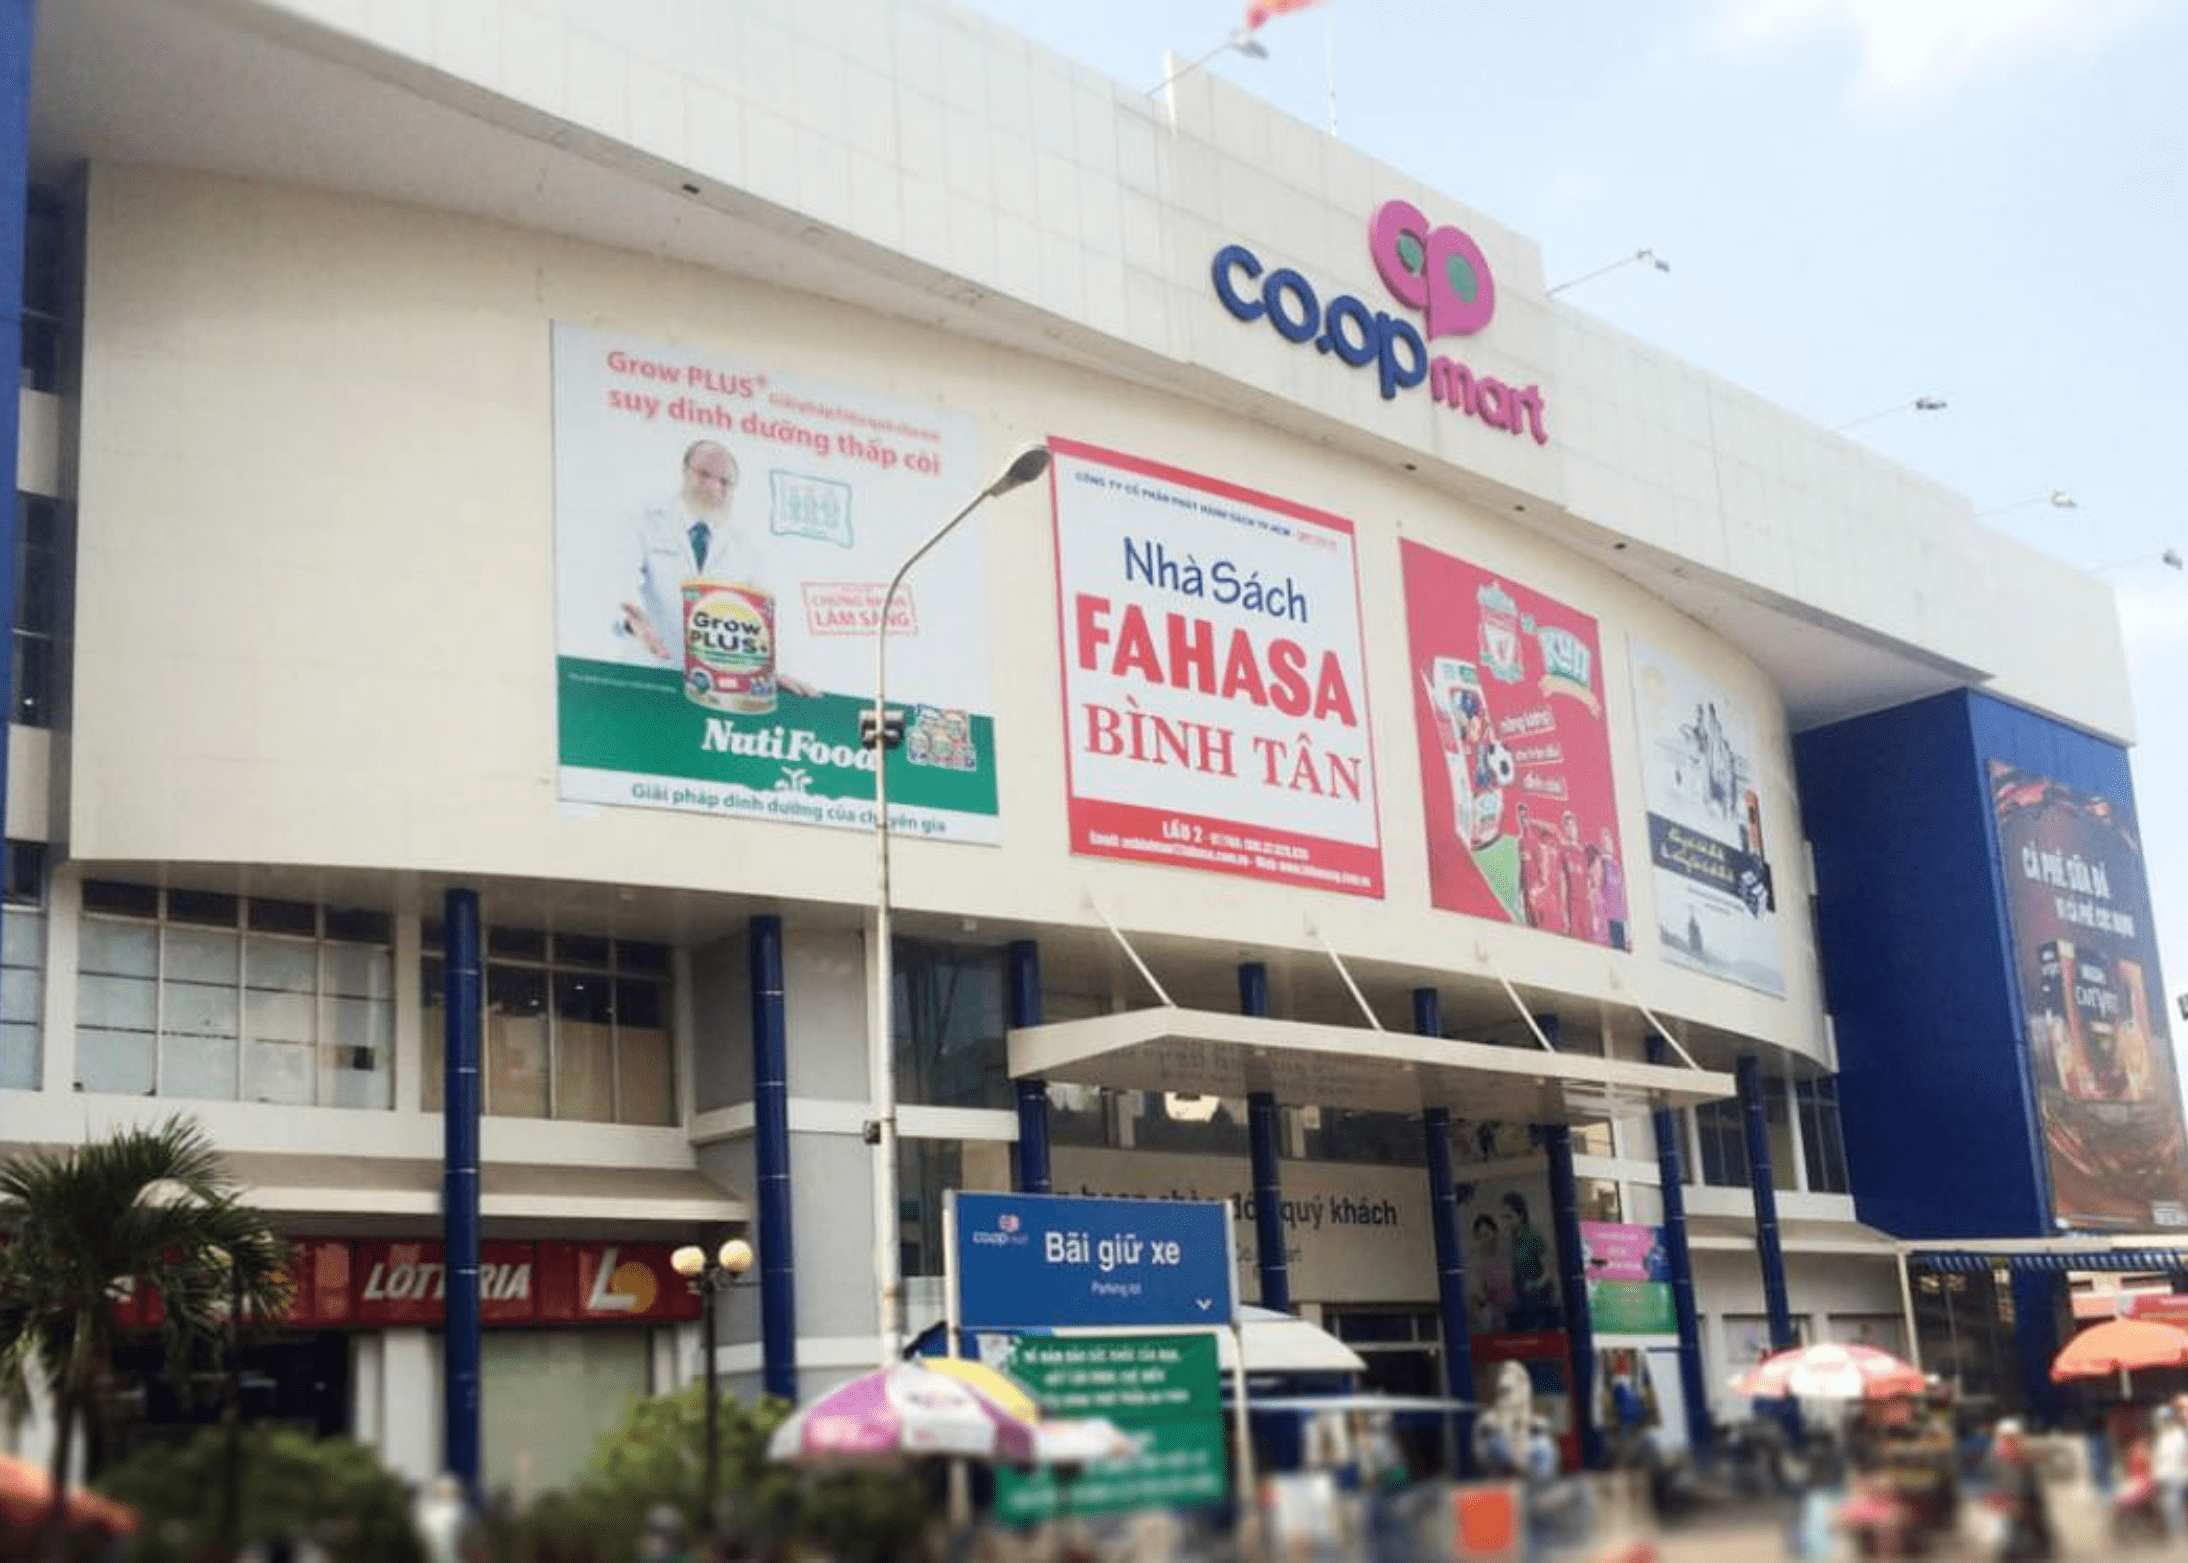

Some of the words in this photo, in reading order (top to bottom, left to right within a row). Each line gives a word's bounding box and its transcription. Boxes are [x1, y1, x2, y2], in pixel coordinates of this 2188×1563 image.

[607, 351, 679, 383] Grow
[608, 388, 660, 420] suy
[667, 396, 732, 430] dinh
[740, 412, 830, 456] dưỡng
[1429, 355, 1548, 445] mart
[1123, 535, 1203, 598] Nhà
[1210, 560, 1308, 624] Sách
[693, 610, 761, 635] Grow
[1076, 591, 1358, 728] FAHASA
[1082, 694, 1237, 777] BÌNH
[1253, 731, 1362, 802] TÂN
[673, 787, 720, 808] pháp
[724, 790, 764, 810] dinh
[1330, 1194, 1398, 1226] khách
[1045, 1230, 1090, 1263] Bãi
[1098, 1232, 1144, 1273] giữ
[1150, 1239, 1181, 1265] xe
